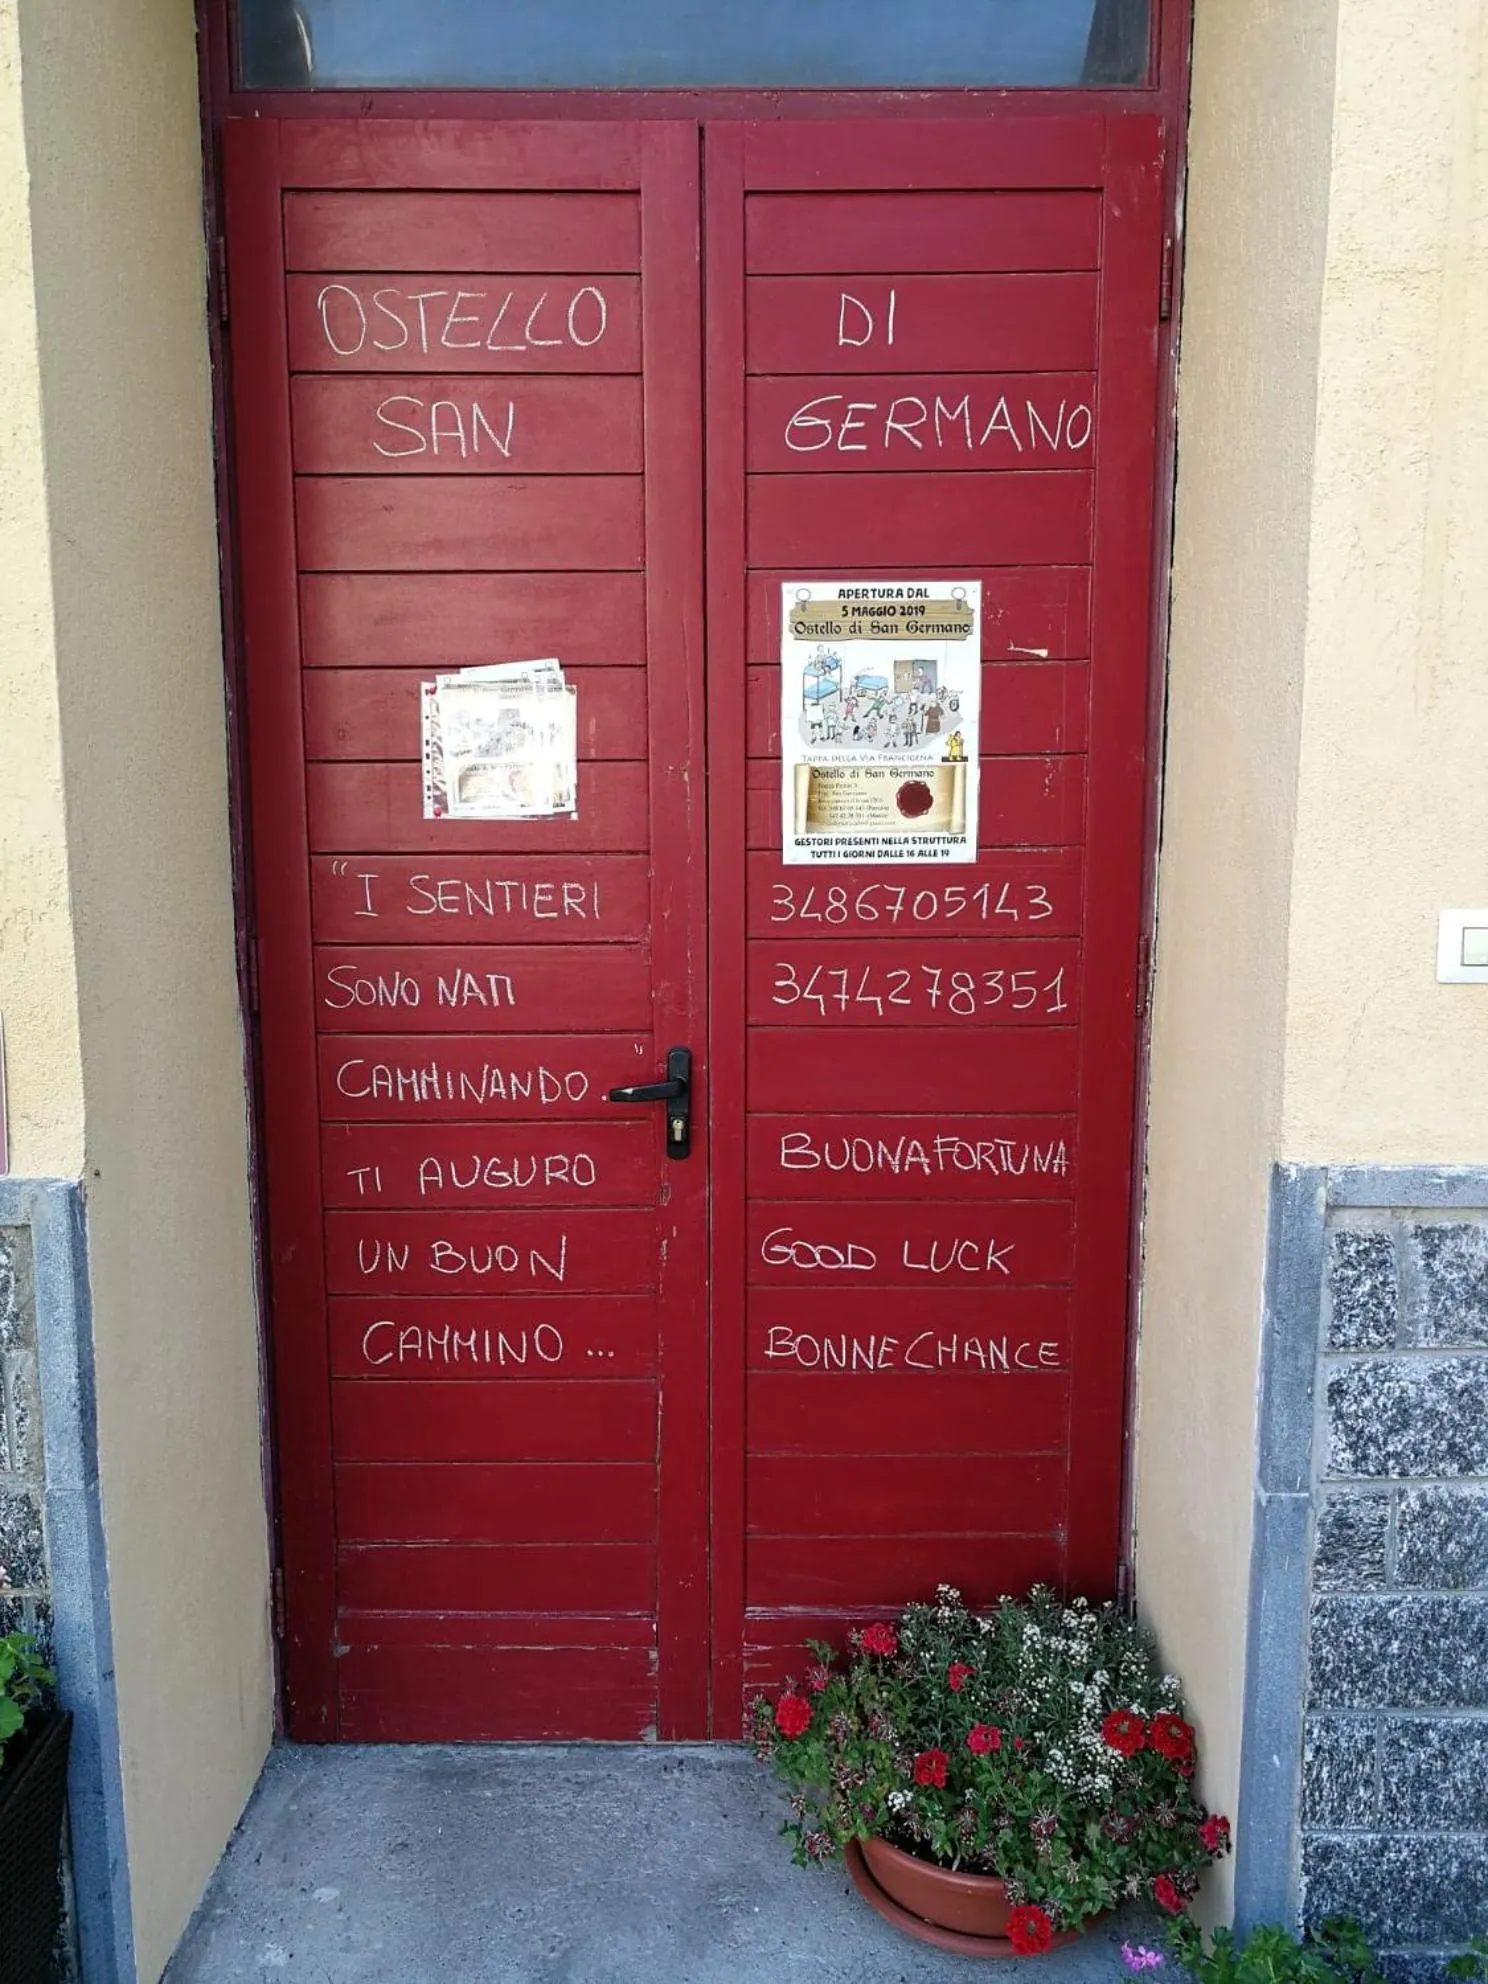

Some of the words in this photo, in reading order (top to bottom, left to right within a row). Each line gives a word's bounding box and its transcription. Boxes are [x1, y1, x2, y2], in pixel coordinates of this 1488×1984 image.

[317, 284, 606, 355] OSTELLO
[838, 289, 896, 346] DI
[373, 396, 514, 459] SAN
[785, 394, 1092, 453] GERMANO
[838, 587, 904, 599] APERTURA
[907, 587, 930, 599] DAL
[841, 605, 849, 617] 5
[851, 605, 896, 617] MAGGIO
[899, 605, 926, 617] 2019
[794, 620, 842, 635] Ostello
[849, 620, 862, 635] di
[870, 620, 899, 635] San
[906, 620, 971, 635] Germano
[812, 768, 844, 779] Ostello
[850, 768, 860, 779] di
[865, 768, 885, 779] San
[890, 768, 935, 779] Germano
[795, 836, 833, 846] GESTORI
[835, 836, 879, 846] PRESENTI
[882, 836, 910, 845] NELLA
[911, 836, 967, 845] STRUTTURA
[811, 849, 836, 859] TUTTI
[843, 849, 875, 858] GIORNI
[877, 849, 905, 858] DALLE
[917, 849, 939, 858] ALLE
[406, 875, 601, 920] SENTIERI
[770, 882, 1053, 924] 3486705143
[325, 965, 420, 1009] SONO
[772, 963, 1068, 1016] 3474278351
[347, 1166, 382, 1197] TI
[419, 1153, 596, 1196] AUGURO
[781, 1132, 932, 1176] BUONA
[933, 1134, 1069, 1177] FORTUNA
[359, 1239, 410, 1275] UN
[430, 1234, 568, 1282] BUON
[761, 1227, 877, 1270] GOOD
[903, 1238, 1015, 1275] LUCK
[764, 1326, 899, 1371] BONNE
[904, 1331, 1061, 1371] CHANCE
